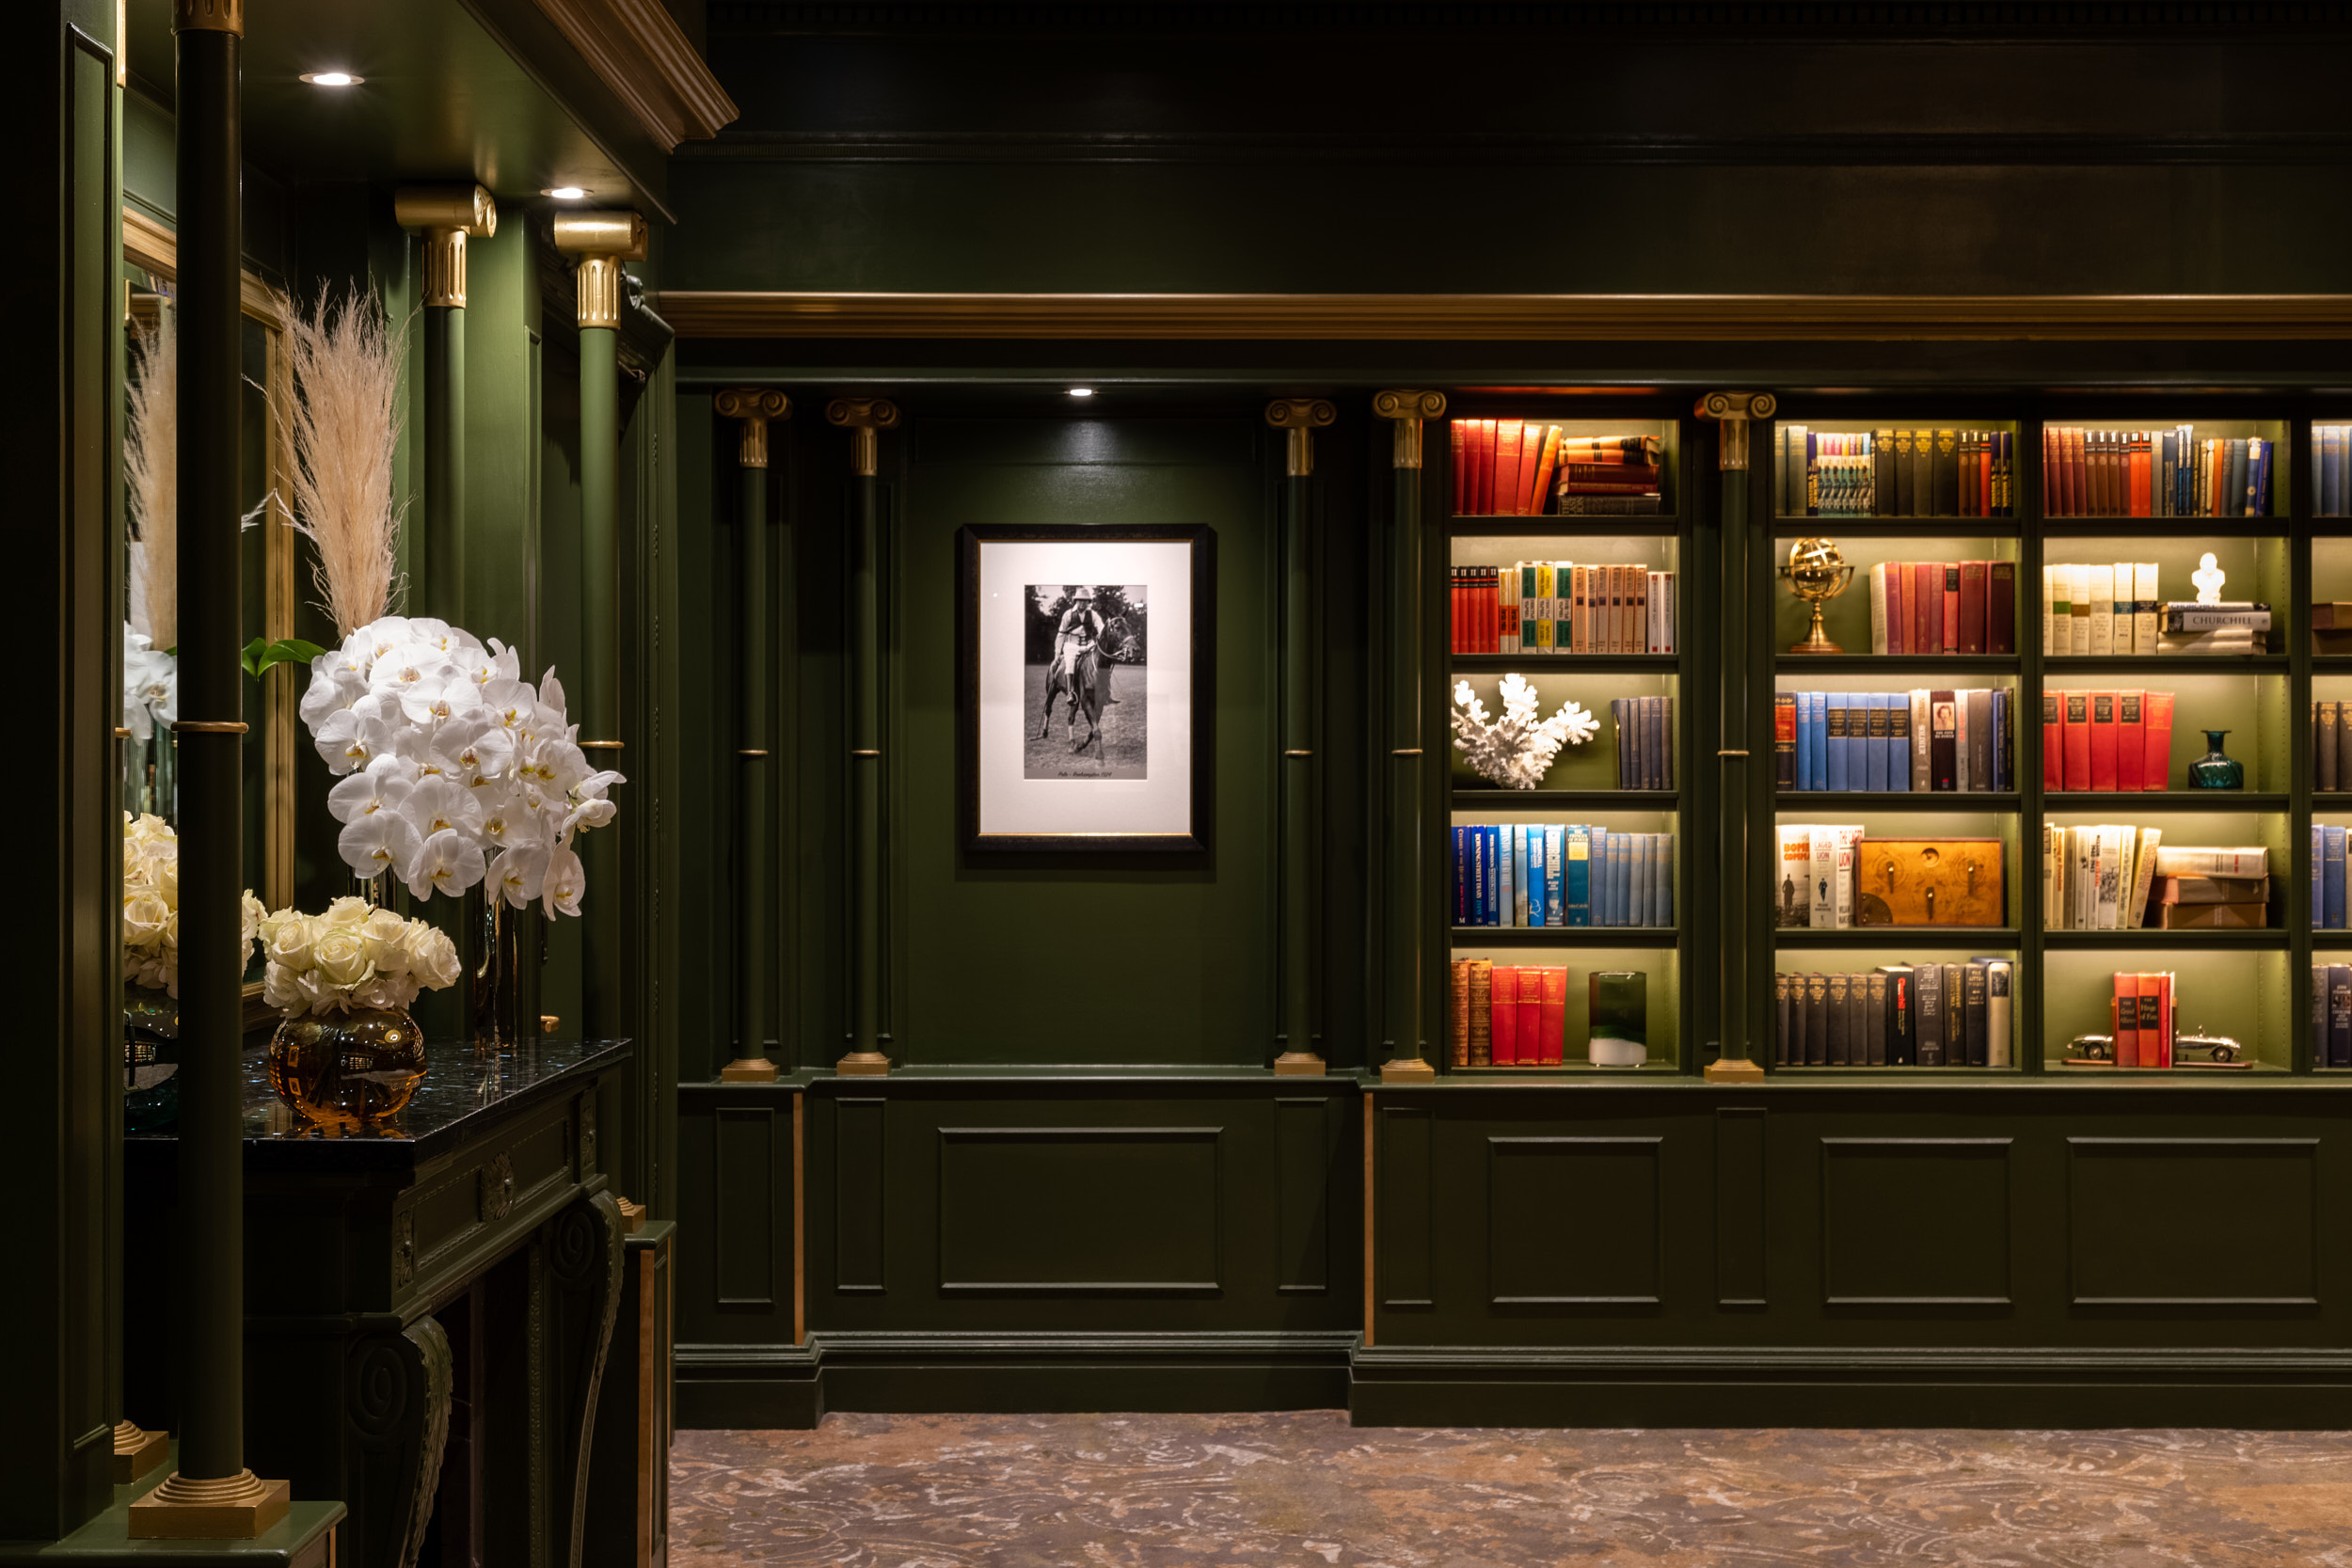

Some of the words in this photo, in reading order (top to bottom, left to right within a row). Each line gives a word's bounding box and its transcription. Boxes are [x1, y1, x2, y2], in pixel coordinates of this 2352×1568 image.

[2193, 617, 2252, 626] CHURCHILL
[1839, 831, 1848, 845] THE
[1547, 830, 1561, 879] CHURCHILL
[1838, 852, 1851, 867] LION
[2141, 1004, 2157, 1012] Hinge
